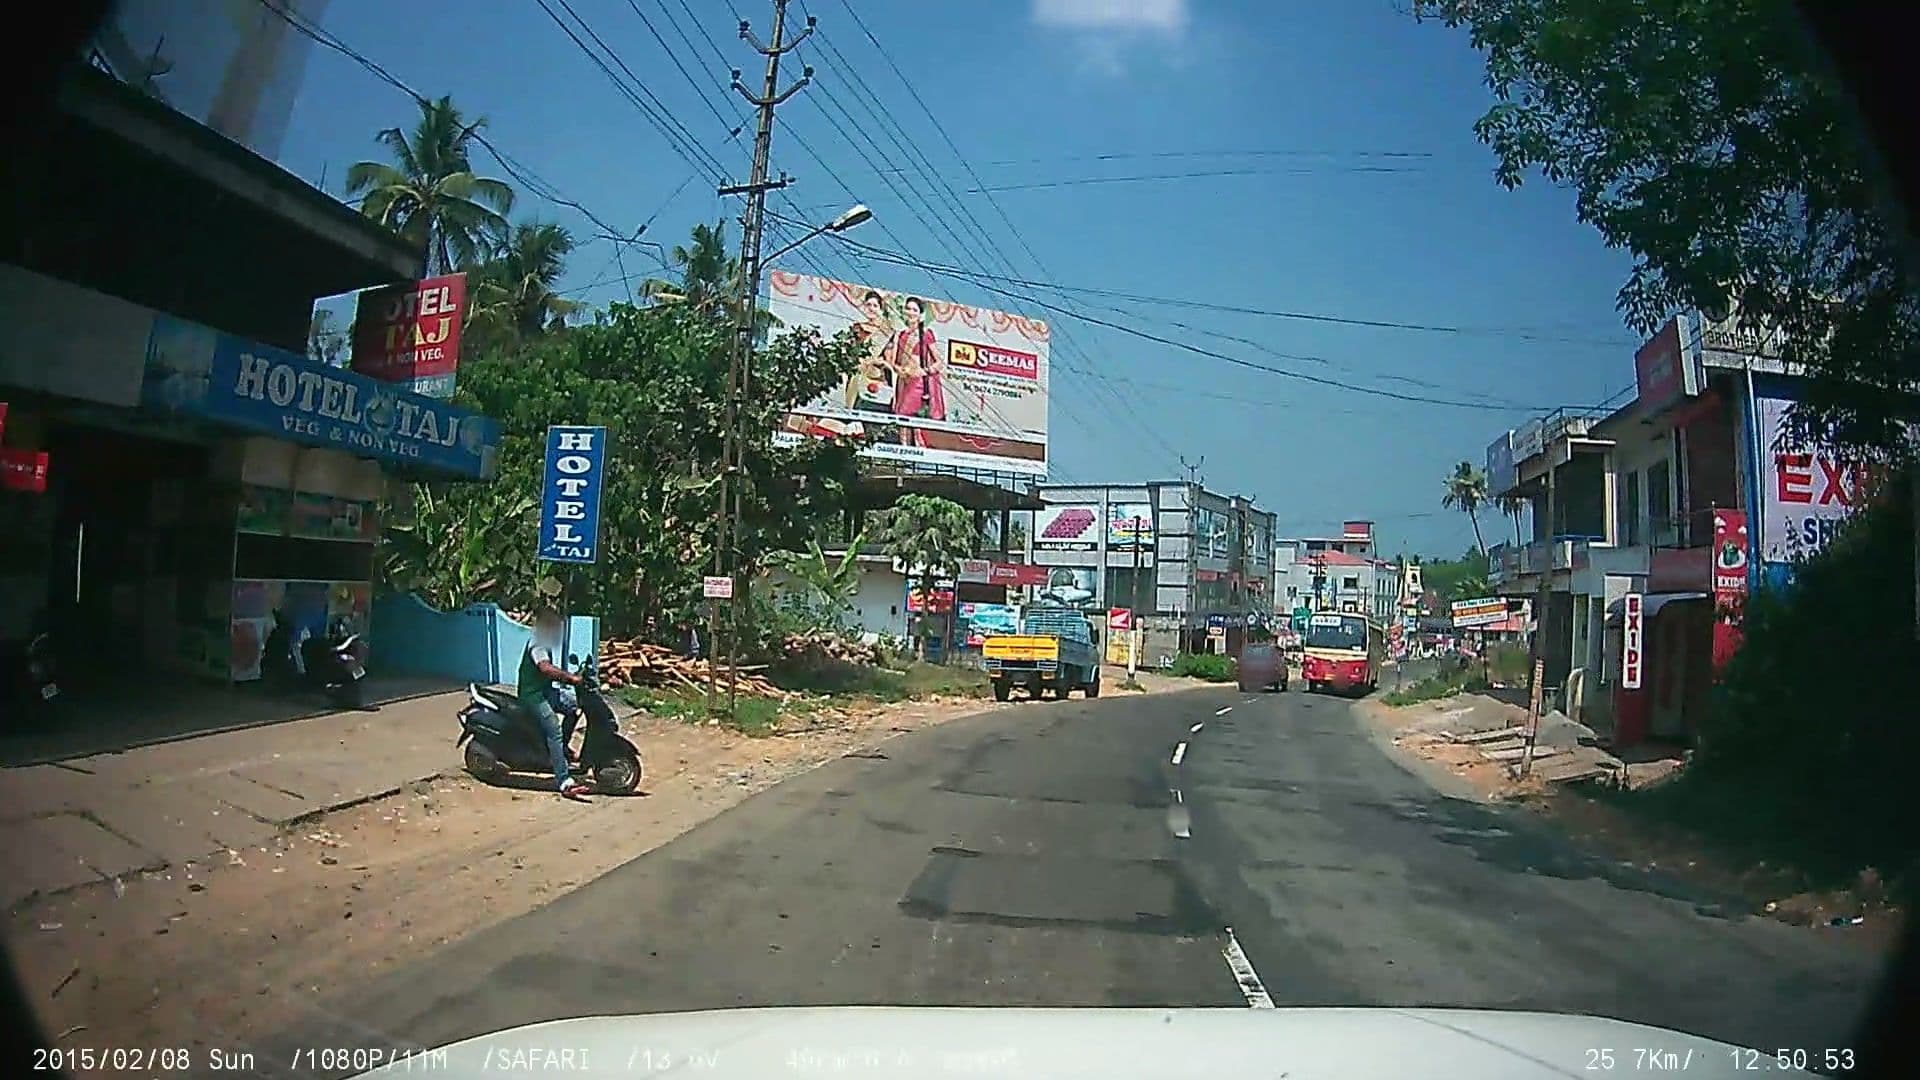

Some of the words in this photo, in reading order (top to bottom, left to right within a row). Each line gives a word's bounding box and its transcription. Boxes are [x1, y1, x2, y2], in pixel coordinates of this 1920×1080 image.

[977, 348, 1035, 371] SEEMAS
[234, 353, 362, 424] HOTEL
[395, 399, 461, 447] TAJ
[282, 416, 320, 436] VEG
[329, 426, 343, 442] &
[349, 429, 384, 450] NON
[553, 433, 594, 543] HOTEL
[557, 546, 591, 557] TAJ
[1626, 597, 1640, 682] EXIDE
